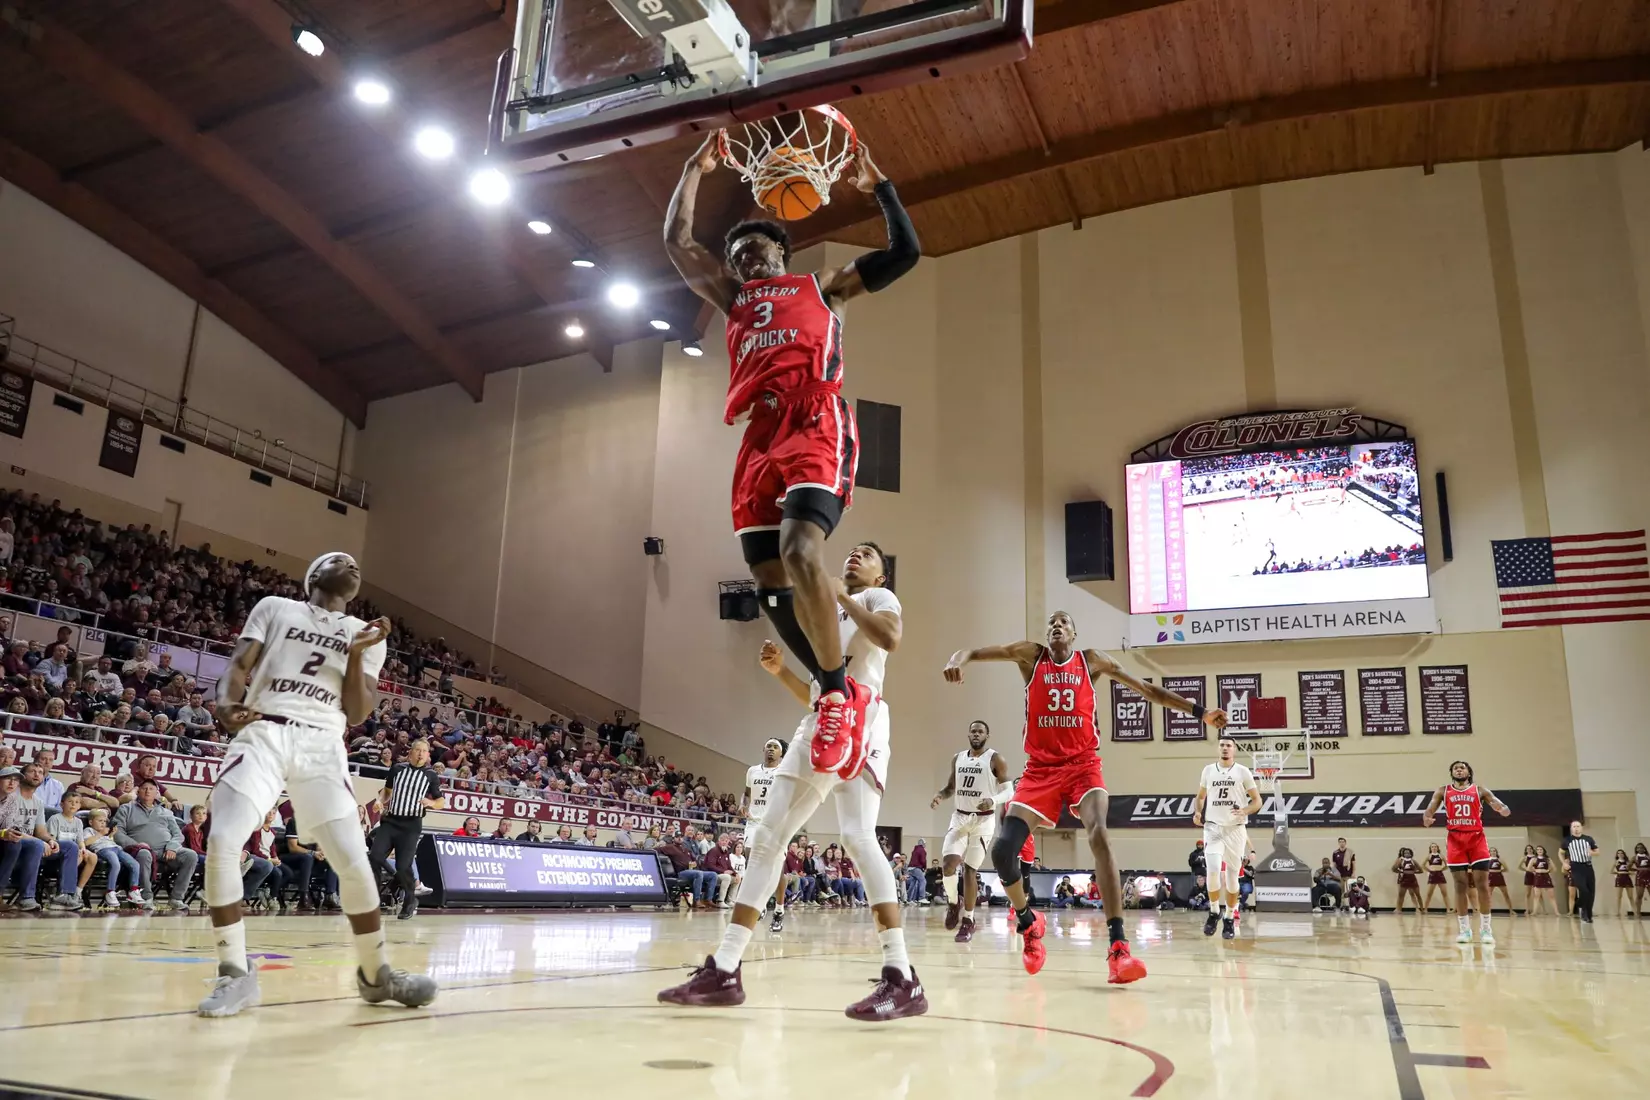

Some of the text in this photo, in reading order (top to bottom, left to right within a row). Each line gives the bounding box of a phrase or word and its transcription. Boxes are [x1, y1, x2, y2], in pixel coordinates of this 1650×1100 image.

[735, 286, 800, 306] WESTERN
[753, 301, 773, 328] 3
[1220, 406, 1356, 428] EASTERN KENTUCKY
[1169, 414, 1362, 459] COLONELS
[1191, 610, 1407, 634] BAPTIST HEALTH ARENA
[86, 629, 105, 642] 214
[285, 627, 349, 655] EASTERN
[150, 643, 168, 654] 215
[301, 651, 326, 677] 2
[1043, 672, 1082, 686] WESTERN
[269, 678, 337, 706] KENTUCKY
[1047, 688, 1075, 712] 33
[1116, 701, 1147, 720] 627
[1232, 709, 1248, 722] 20
[1038, 715, 1084, 728] KENTUCKY
[1275, 742, 1291, 751] OF
[1297, 741, 1341, 751] HONOR
[957, 766, 982, 774] EASTERN
[962, 776, 975, 788] 10
[760, 786, 767, 798] 3
[957, 789, 982, 797] KENTUCKY
[1218, 787, 1229, 799] 15
[1449, 794, 1475, 803] WESTERN
[514, 801, 541, 818] OF
[549, 805, 589, 823] THE
[1132, 797, 1196, 815] EKU
[1454, 803, 1471, 817] 20
[1448, 818, 1477, 826] KENTUCKY
[436, 841, 523, 860] TOWNEPLACE
[465, 861, 504, 875] SUITES
[542, 854, 643, 871] RICHMOND'S PREMIER
[536, 870, 655, 887] EXTENDED STAY LODGING
